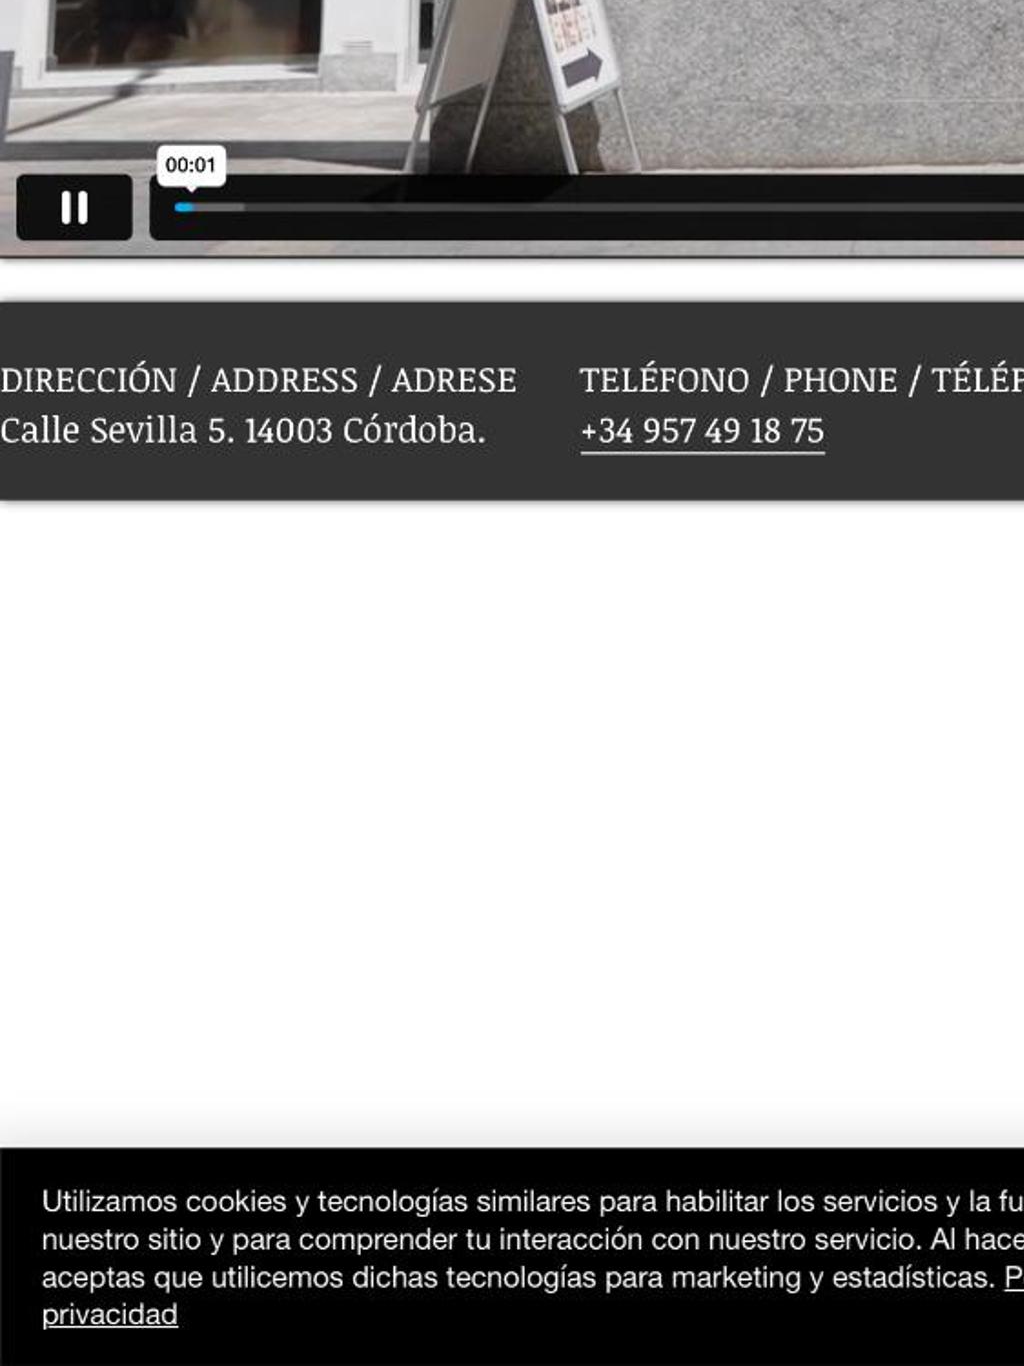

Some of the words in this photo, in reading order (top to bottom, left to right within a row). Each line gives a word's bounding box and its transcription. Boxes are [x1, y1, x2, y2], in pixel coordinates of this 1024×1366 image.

[165, 156, 214, 173] 00:01
[1, 360, 177, 393] DIRECCIÓN
[211, 368, 357, 392] ADDRESS
[391, 368, 516, 392] ADRESE
[579, 360, 749, 393] TELÉFONO
[785, 368, 897, 392] PHONE
[1, 415, 79, 443] Calle
[91, 415, 197, 443] Sevilla
[209, 418, 233, 443] 5.
[246, 417, 332, 443] 14003
[344, 413, 485, 443] Córdoba.
[582, 418, 632, 443] +34
[644, 418, 696, 443] 957
[705, 418, 740, 443] 49
[752, 418, 780, 443] 18
[791, 418, 823, 443] 75
[43, 1189, 177, 1212] Utilizamos
[186, 1189, 286, 1212] cookies
[295, 1196, 310, 1217] y
[317, 1187, 468, 1217] tecnologías
[477, 1189, 590, 1212] similares
[600, 1195, 658, 1217] para
[666, 1189, 769, 1212] habilitar
[778, 1189, 815, 1212] los
[823, 1189, 938, 1212] servicios
[946, 1195, 960, 1217] y
[970, 1189, 991, 1212] la
[43, 1229, 139, 1250] nuestro
[149, 1227, 201, 1250] sitio
[210, 1233, 224, 1255] y
[233, 1233, 291, 1255] para
[299, 1227, 458, 1255] comprender
[466, 1229, 490, 1250] tu
[500, 1226, 642, 1250] interacción
[652, 1233, 699, 1250] con
[710, 1229, 806, 1250] nuestro
[815, 1227, 921, 1250] servicio.
[930, 1227, 955, 1250] Al
[42, 1267, 145, 1293] aceptas
[154, 1271, 203, 1293] que
[212, 1265, 343, 1288] utilicemos
[353, 1266, 438, 1288] dichas
[446, 1264, 596, 1294] tecnologías
[606, 1271, 663, 1293] para
[672, 1265, 800, 1294] marketing
[810, 1271, 824, 1294] y
[833, 1264, 994, 1288] estadísticas.
[43, 1302, 179, 1330] privacidad
